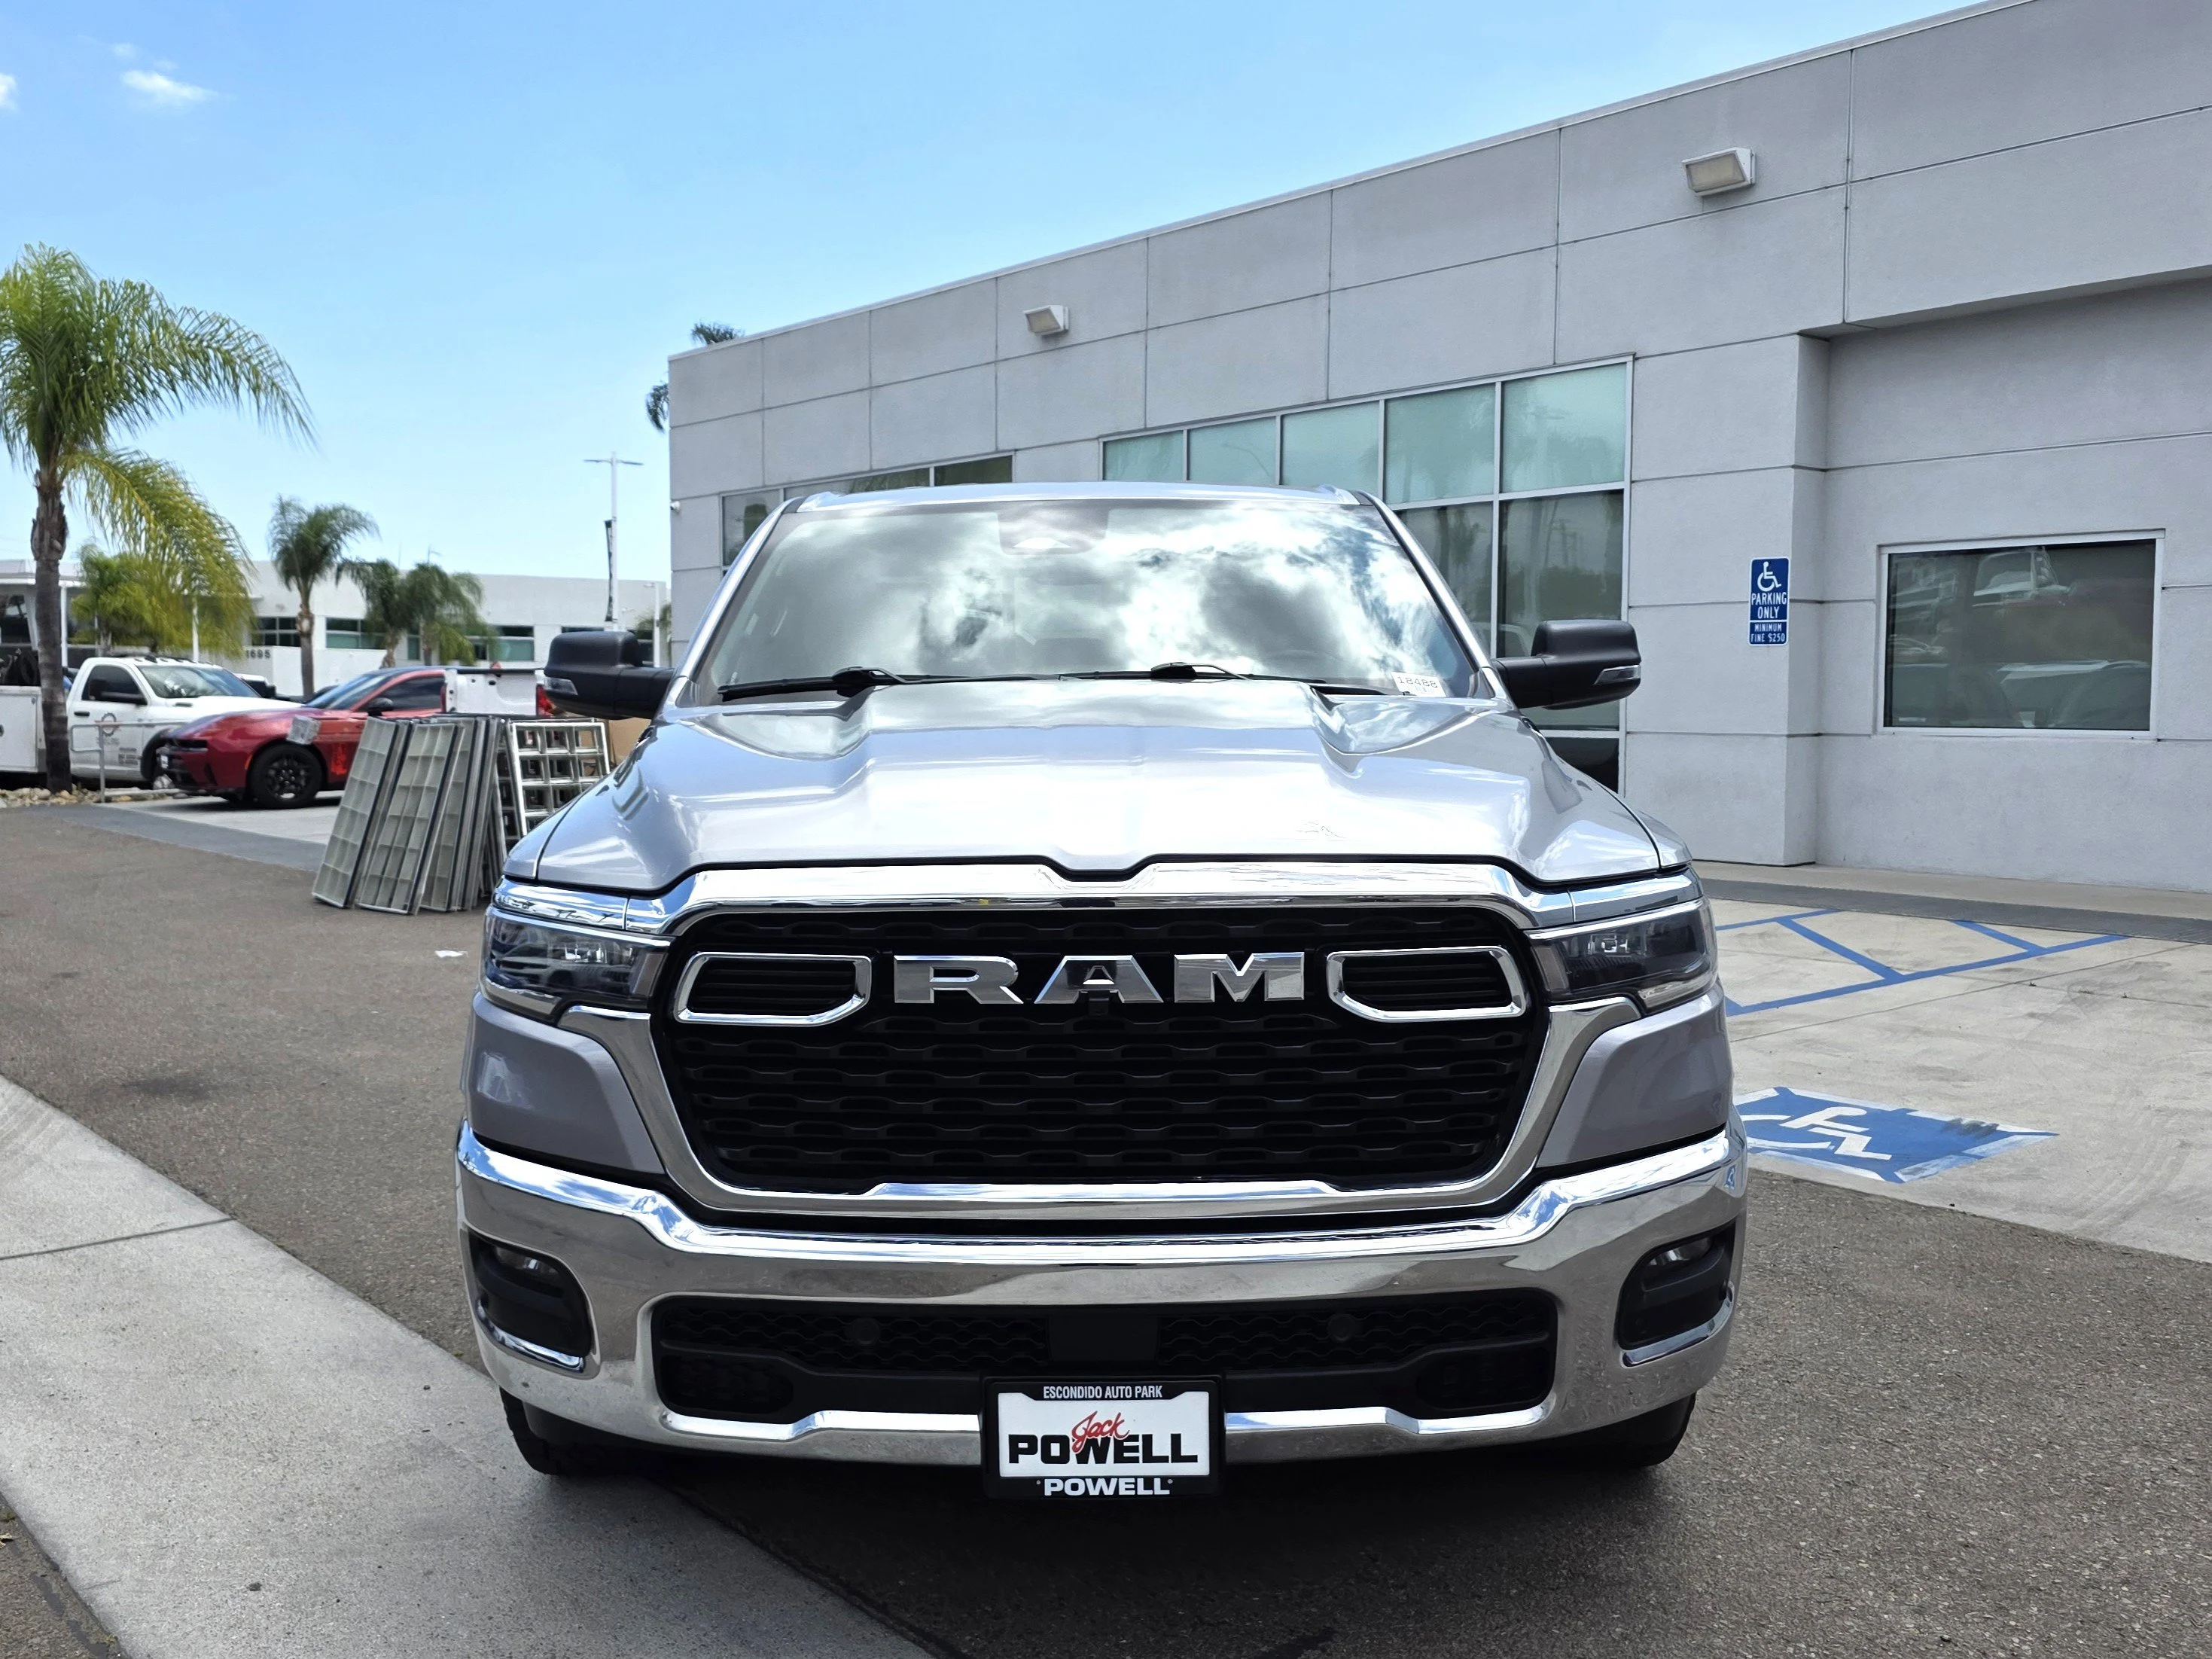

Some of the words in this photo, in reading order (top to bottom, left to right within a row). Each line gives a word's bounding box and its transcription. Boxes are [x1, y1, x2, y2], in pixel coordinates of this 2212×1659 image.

[1751, 592, 1787, 605] PARKING
[1757, 606, 1780, 619] ONLY
[1754, 623, 1782, 632] MINIMUM
[1750, 633, 1766, 642] FINE
[1768, 633, 1785, 642] $250
[894, 952, 1305, 1005] RAM
[1043, 1386, 1101, 1399] ESCONDIDO
[1104, 1386, 1132, 1398] AUTO
[1135, 1385, 1163, 1398] PARK
[1071, 1410, 1130, 1453] Jack
[1008, 1433, 1199, 1465] POWELL
[1044, 1478, 1171, 1496] POWELL
